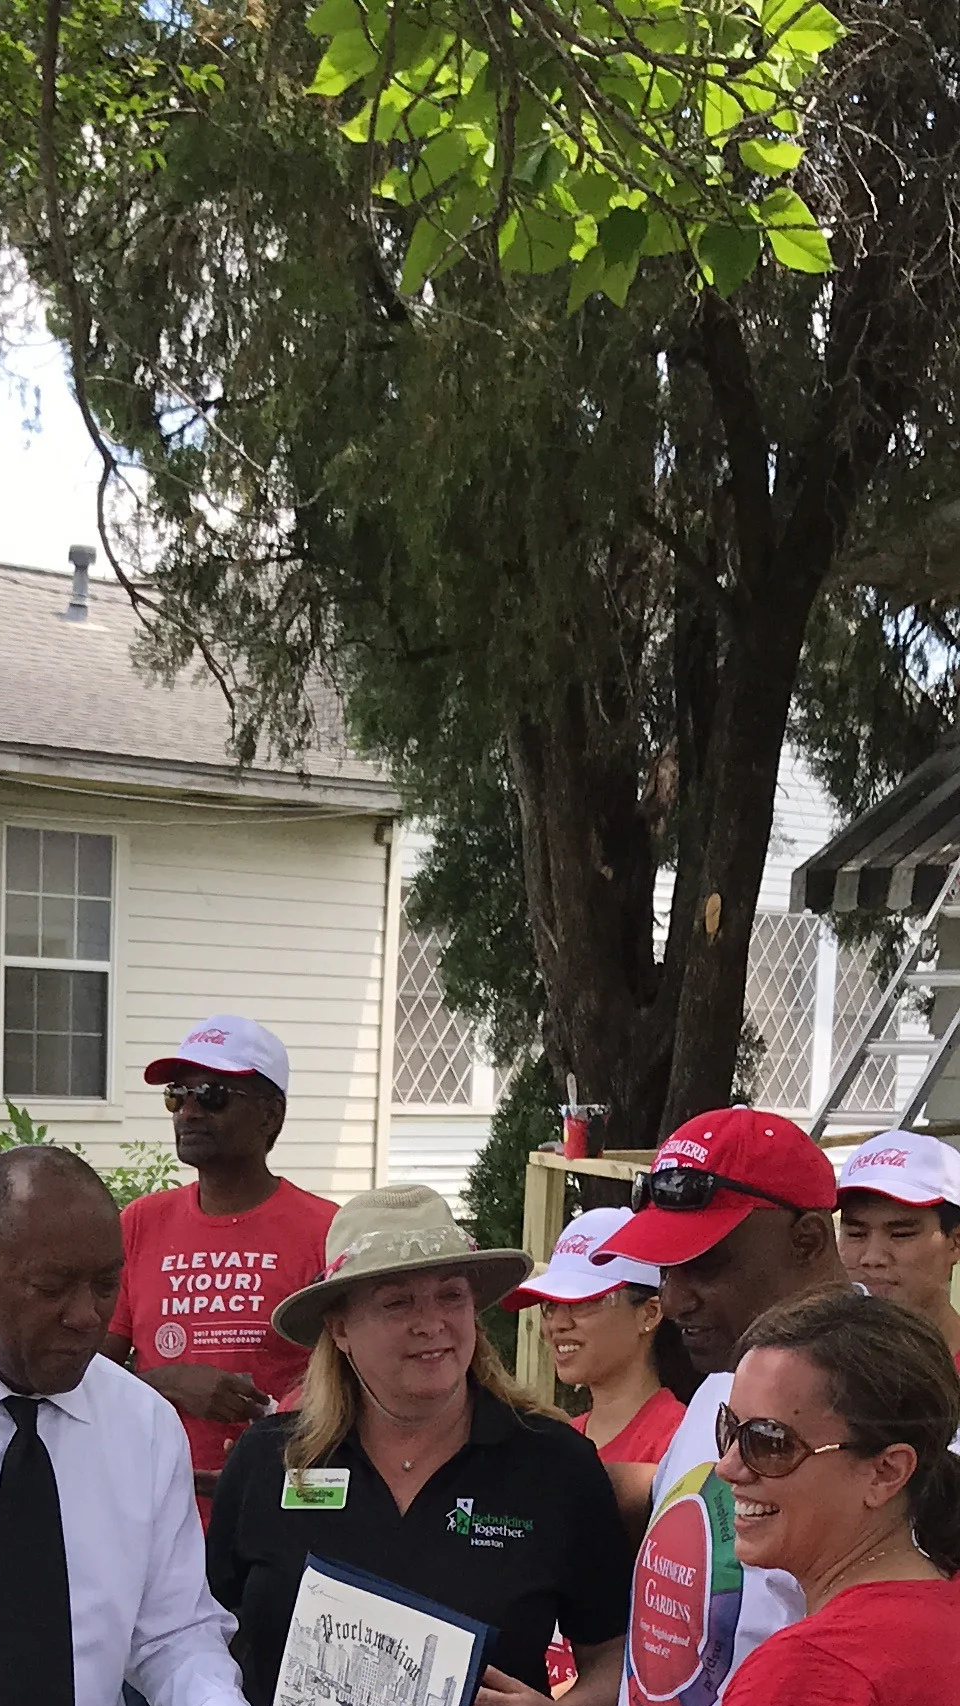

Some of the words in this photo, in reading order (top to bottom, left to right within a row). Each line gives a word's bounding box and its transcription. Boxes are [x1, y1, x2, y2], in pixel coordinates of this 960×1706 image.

[161, 1252, 278, 1272] ELEVATE
[169, 1273, 262, 1293] Y(OUR)
[161, 1295, 265, 1316] IMPACT
[222, 1336, 261, 1344] COLORADO
[472, 1513, 534, 1531] Rebuilding
[470, 1538, 504, 1548] Houston
[321, 1614, 421, 1681] Proclamation
